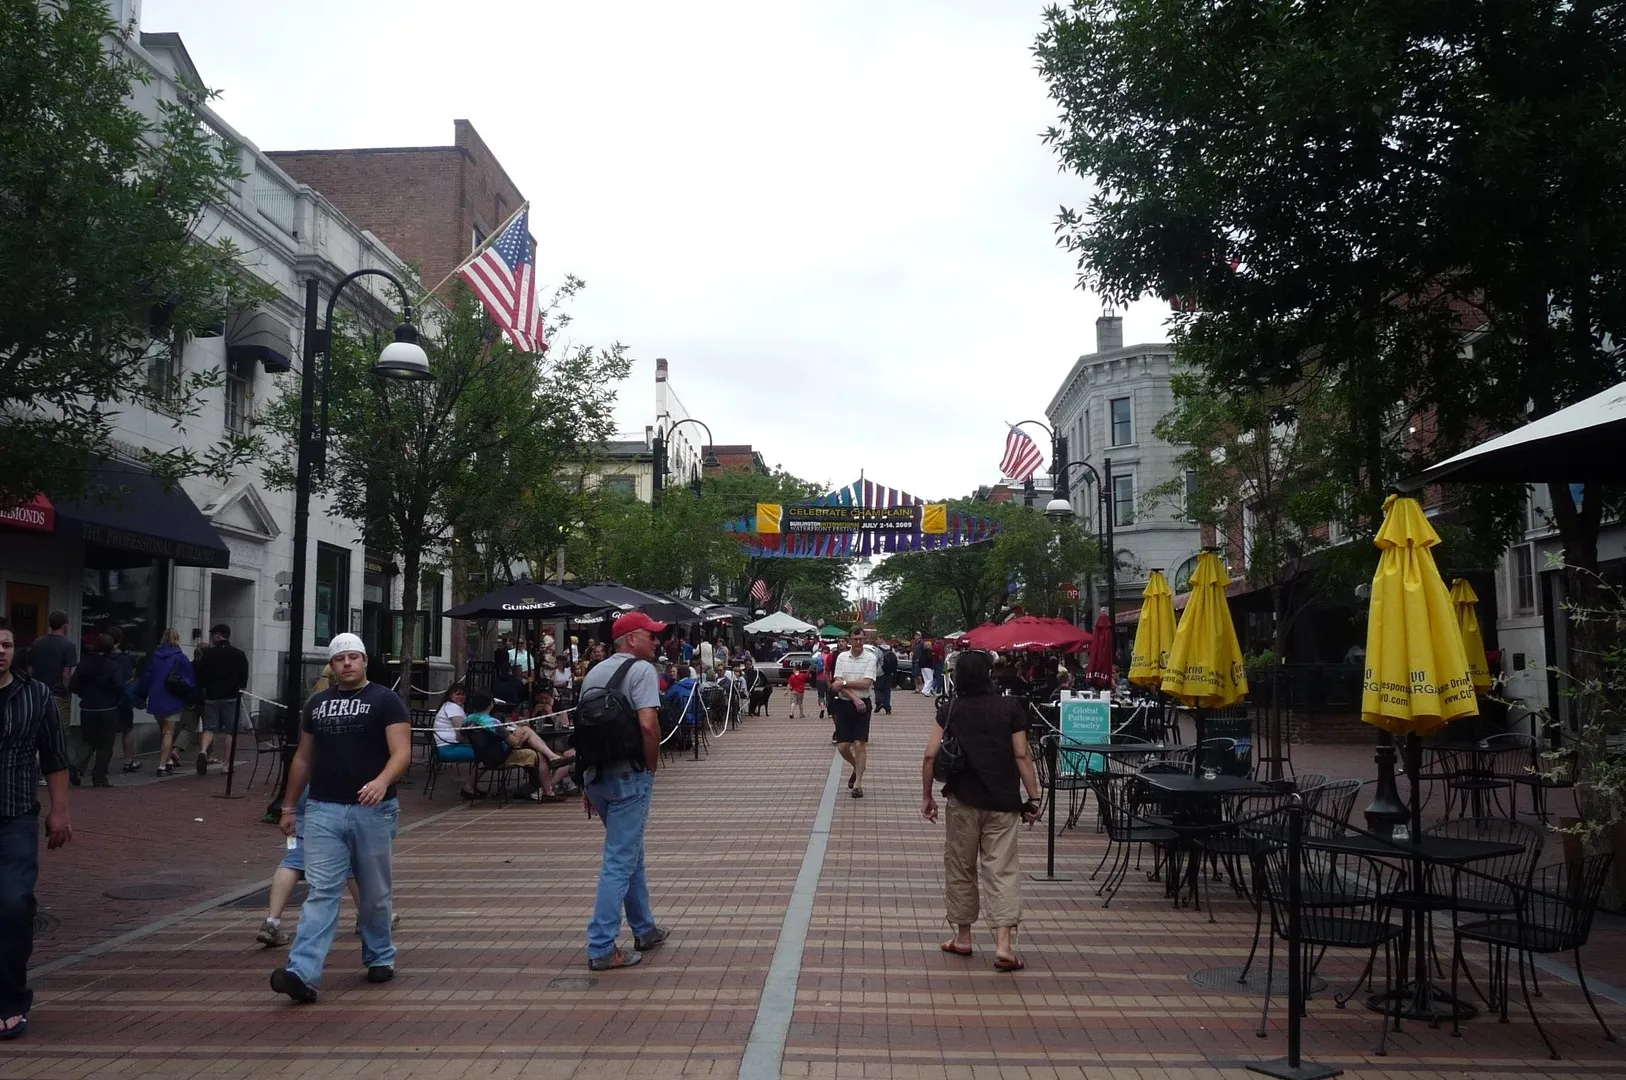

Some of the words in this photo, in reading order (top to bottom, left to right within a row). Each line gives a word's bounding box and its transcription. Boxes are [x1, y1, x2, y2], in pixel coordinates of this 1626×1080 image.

[789, 508, 847, 517] CELEBRATE
[850, 508, 914, 517] CHAMPLAIN!
[879, 522, 895, 530] 2-14,
[501, 601, 557, 611] GUINNESS
[573, 616, 604, 624] GUINNESS
[1072, 706, 1099, 714] Global
[1068, 714, 1104, 722] Pathways
[1072, 721, 1101, 731] Jewelry
